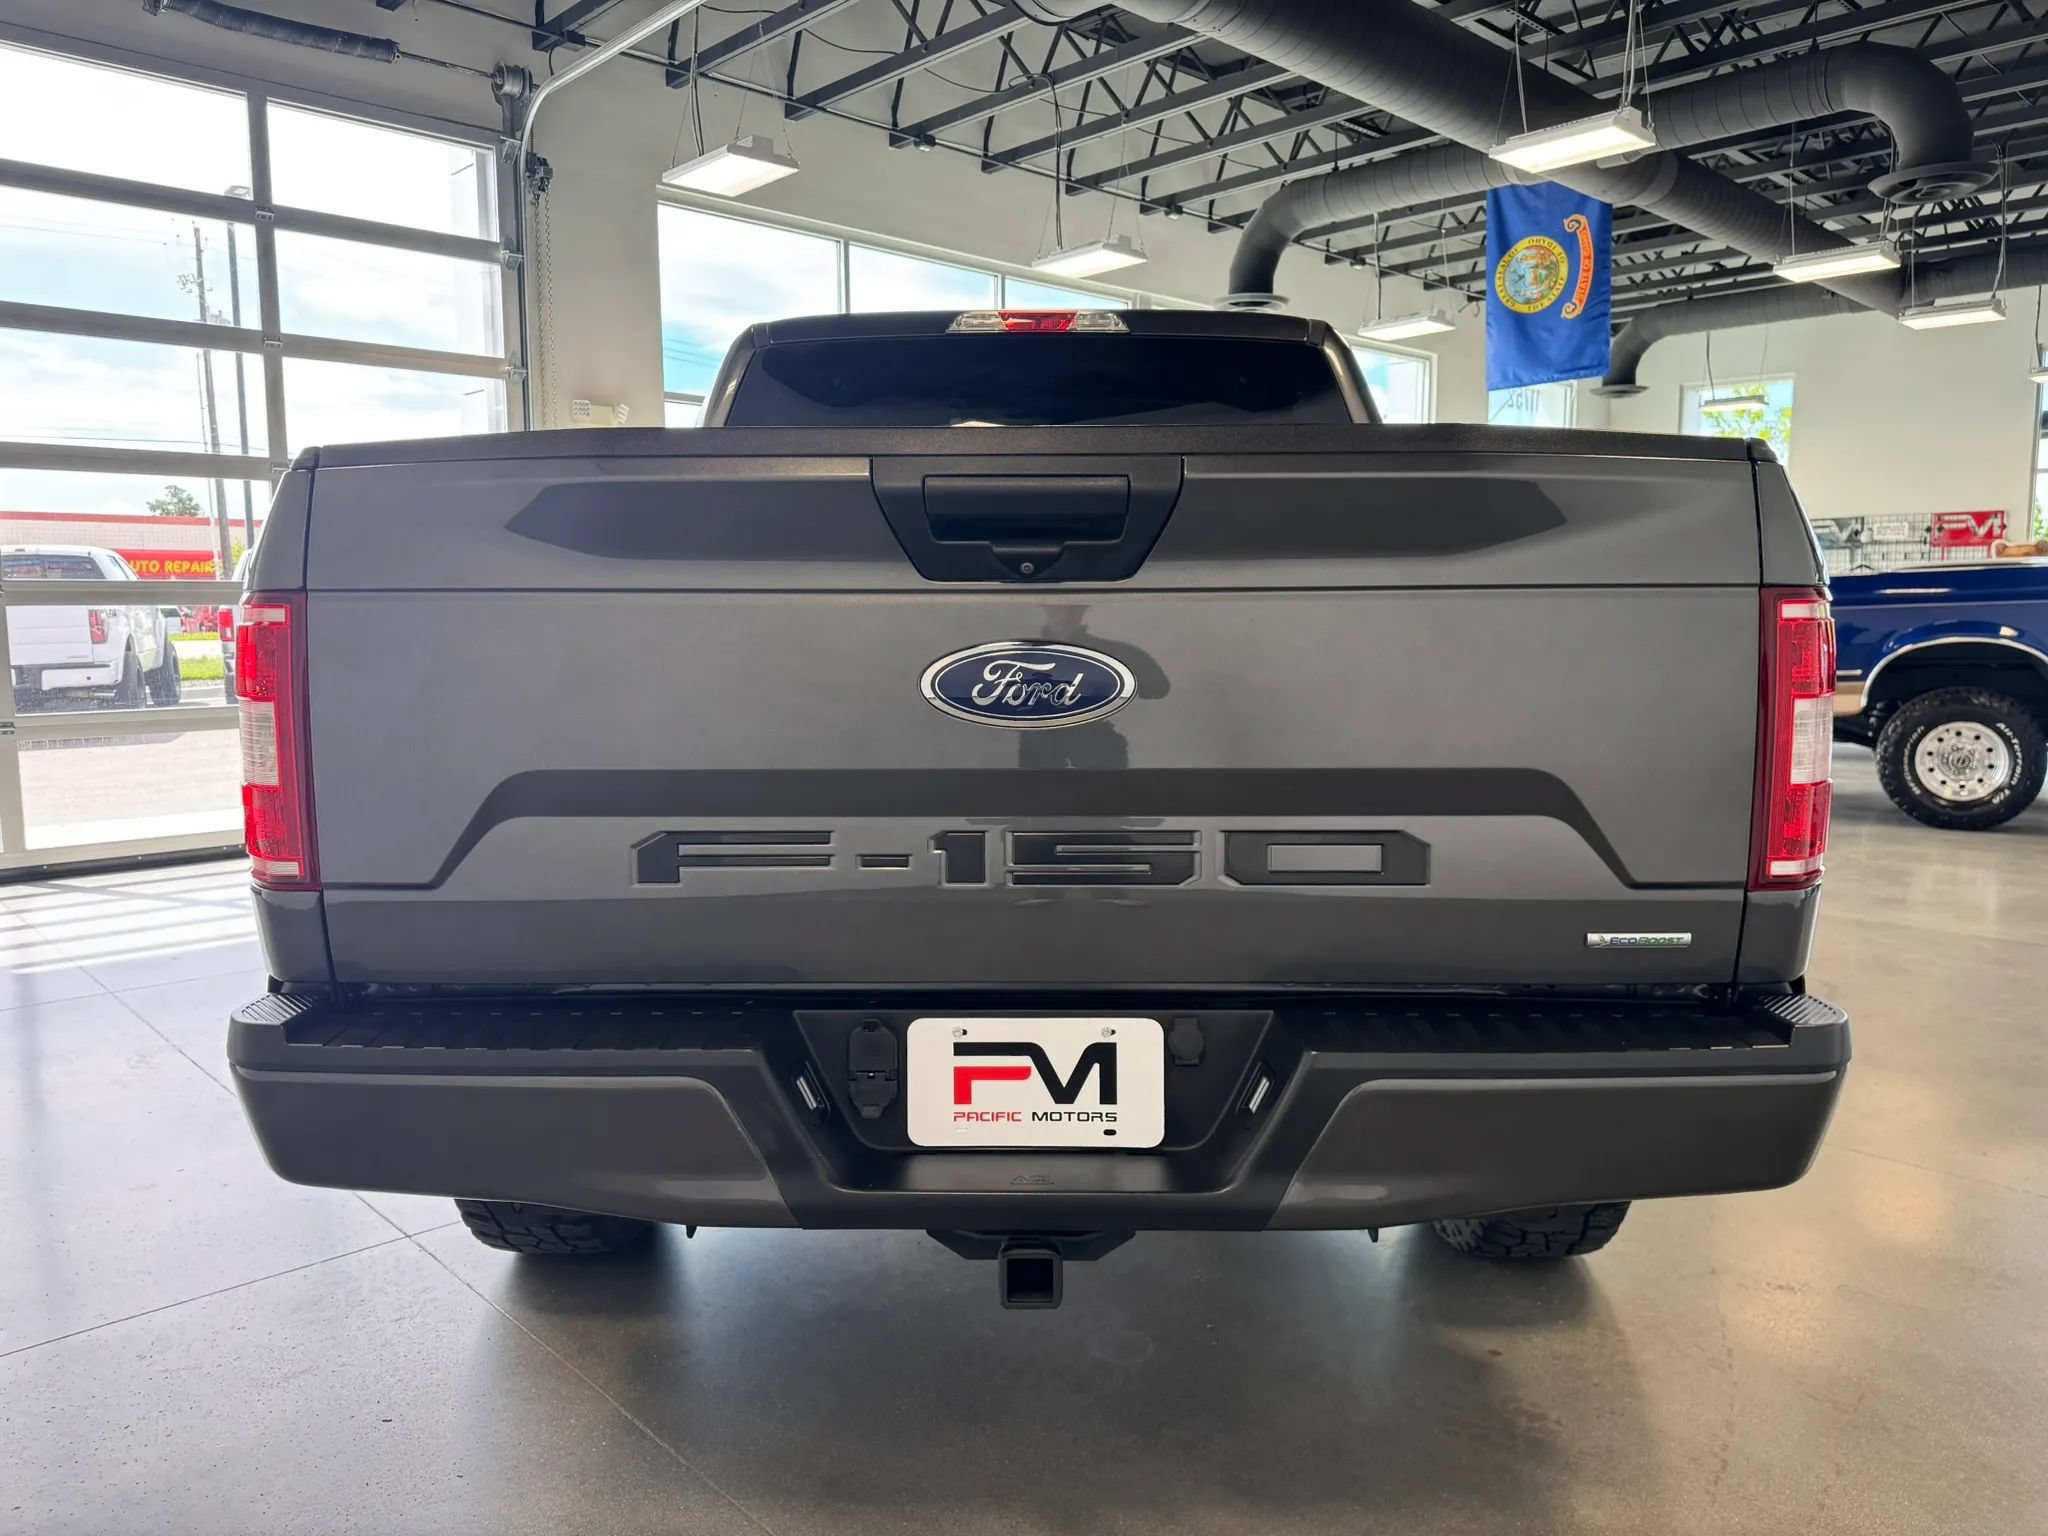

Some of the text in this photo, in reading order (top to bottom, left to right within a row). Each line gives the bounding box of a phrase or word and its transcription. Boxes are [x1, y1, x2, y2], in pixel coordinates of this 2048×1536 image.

[128, 559, 160, 574] UTO
[971, 659, 1084, 706] Ford
[631, 830, 1432, 886] F-150
[953, 1042, 1117, 1104] PM
[953, 1111, 1117, 1122] PACIFIC MOTORS
